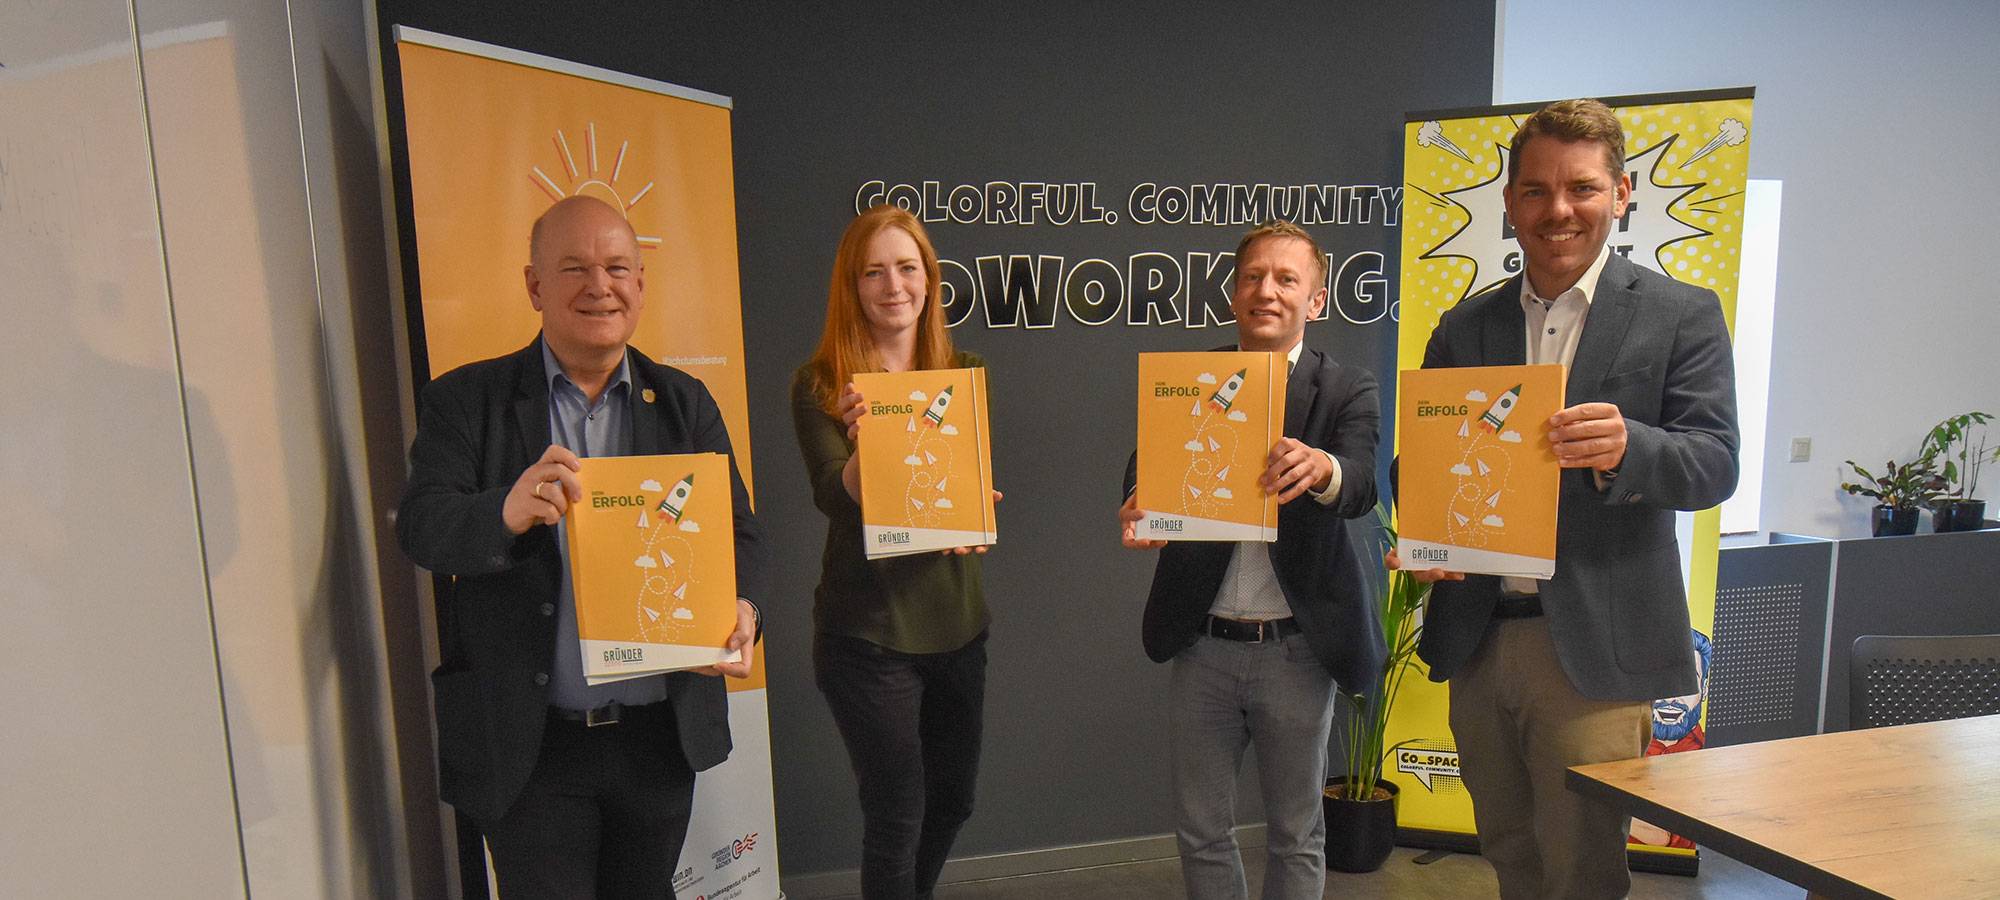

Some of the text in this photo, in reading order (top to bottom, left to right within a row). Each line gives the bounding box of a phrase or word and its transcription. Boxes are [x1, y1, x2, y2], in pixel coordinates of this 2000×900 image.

[855, 180, 1118, 226] COLORFUL.
[1154, 386, 1200, 397] ERFOLG
[871, 404, 913, 416] ERFOLG
[1417, 405, 1468, 417] ERFOLG
[592, 495, 645, 508] ERFOLG
[1400, 752, 1460, 767] CO_SPAC
[747, 866, 761, 878] Arbeit
